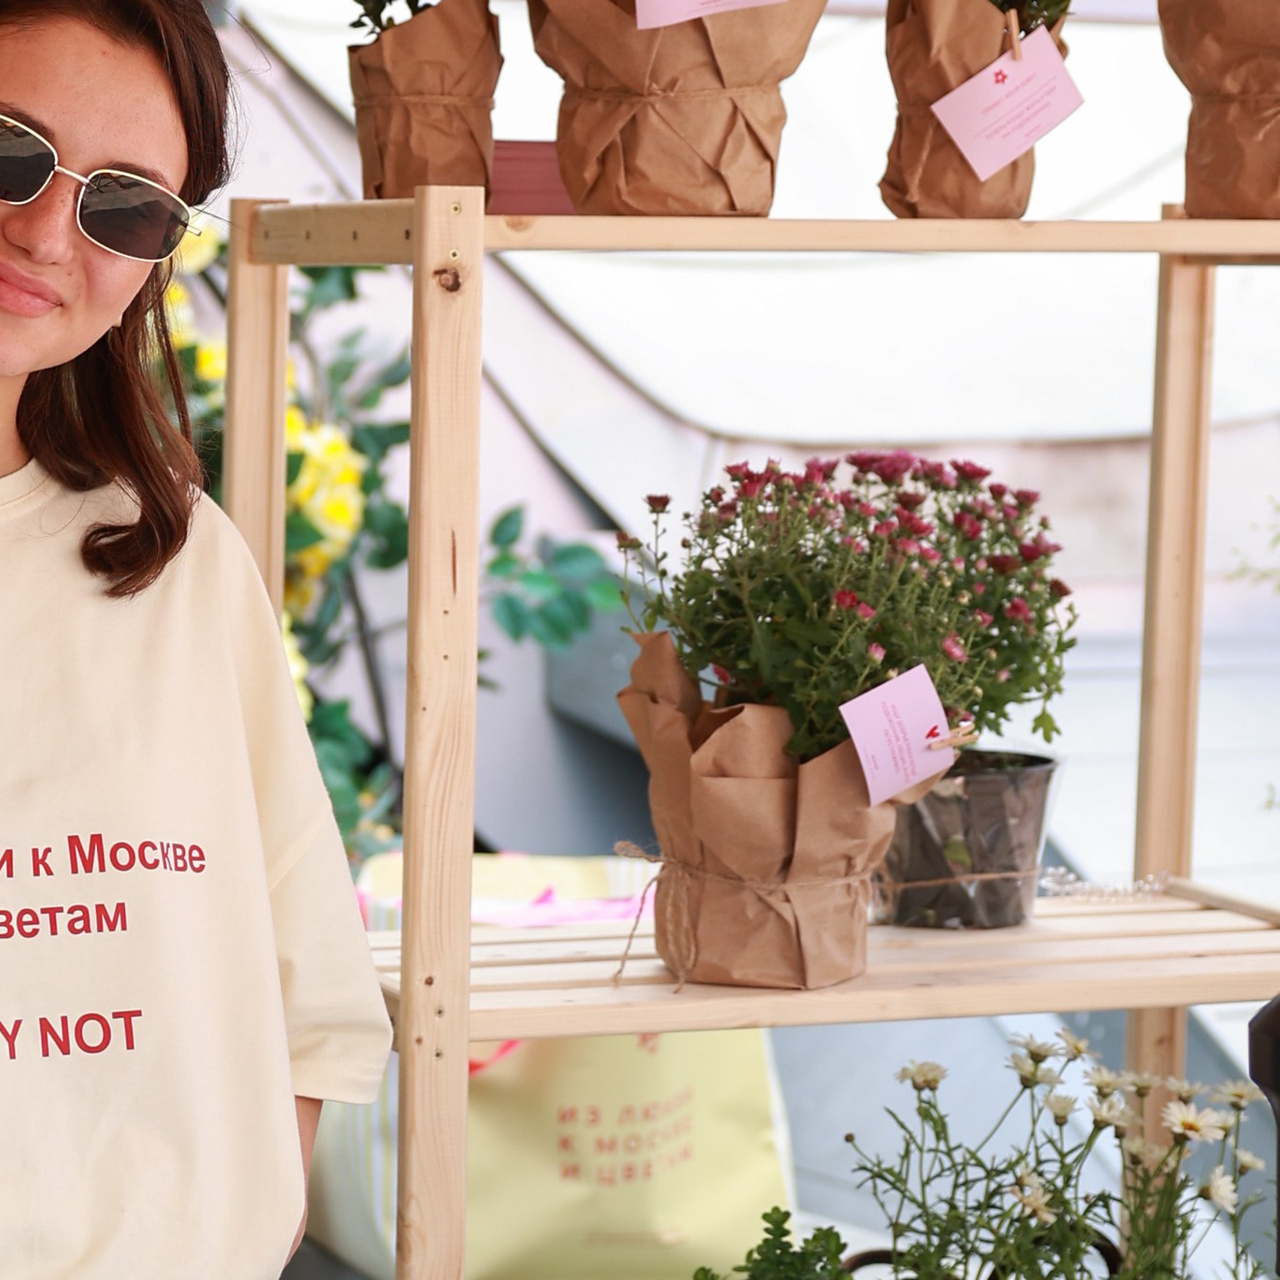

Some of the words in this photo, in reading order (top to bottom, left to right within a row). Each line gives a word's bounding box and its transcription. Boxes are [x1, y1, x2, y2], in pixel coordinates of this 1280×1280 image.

[32, 846, 54, 877] к
[67, 833, 207, 875] Москве
[38, 1009, 142, 1058] NOT
